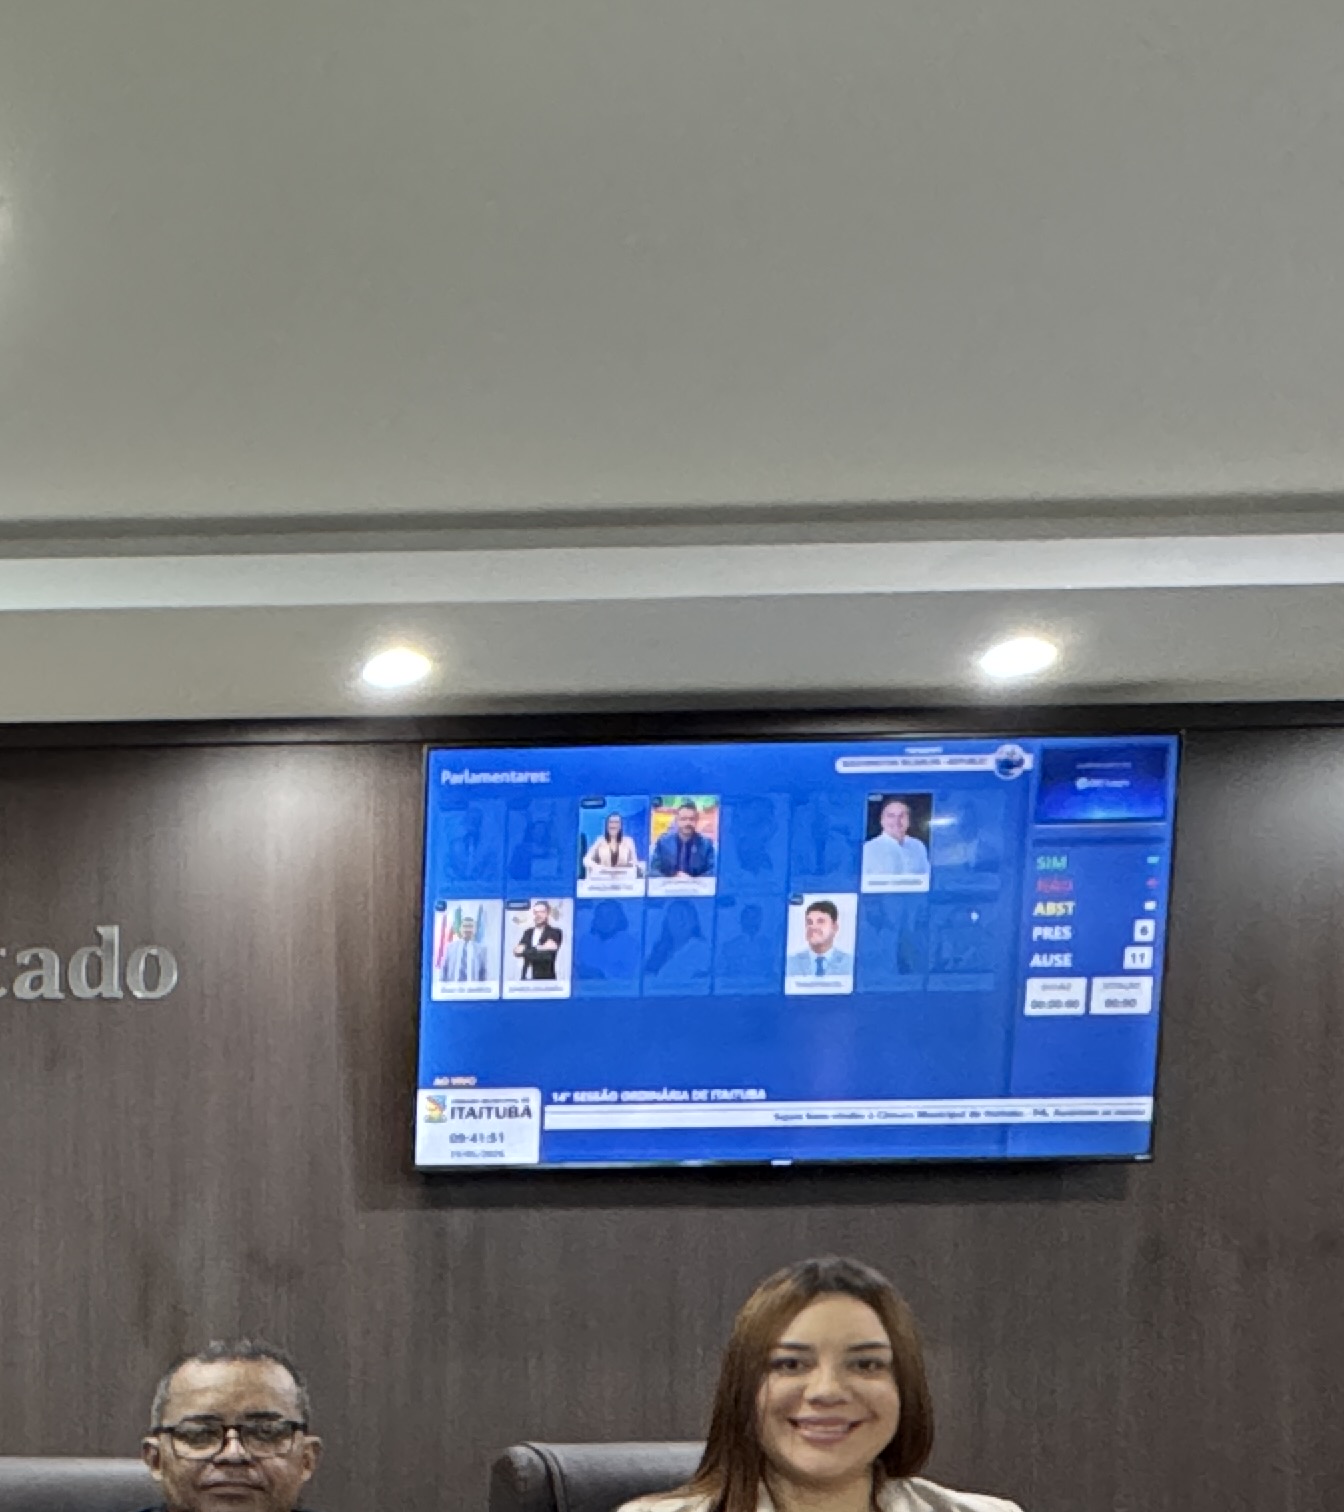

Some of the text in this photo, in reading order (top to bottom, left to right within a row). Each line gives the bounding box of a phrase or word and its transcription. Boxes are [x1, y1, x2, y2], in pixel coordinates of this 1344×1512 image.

[441, 769, 551, 785] Parlamentares:
[1033, 901, 1076, 916] ABST
[1033, 925, 1072, 941] PRES
[1029, 953, 1073, 968] AUSE
[450, 1105, 533, 1120] ITAITUBA
